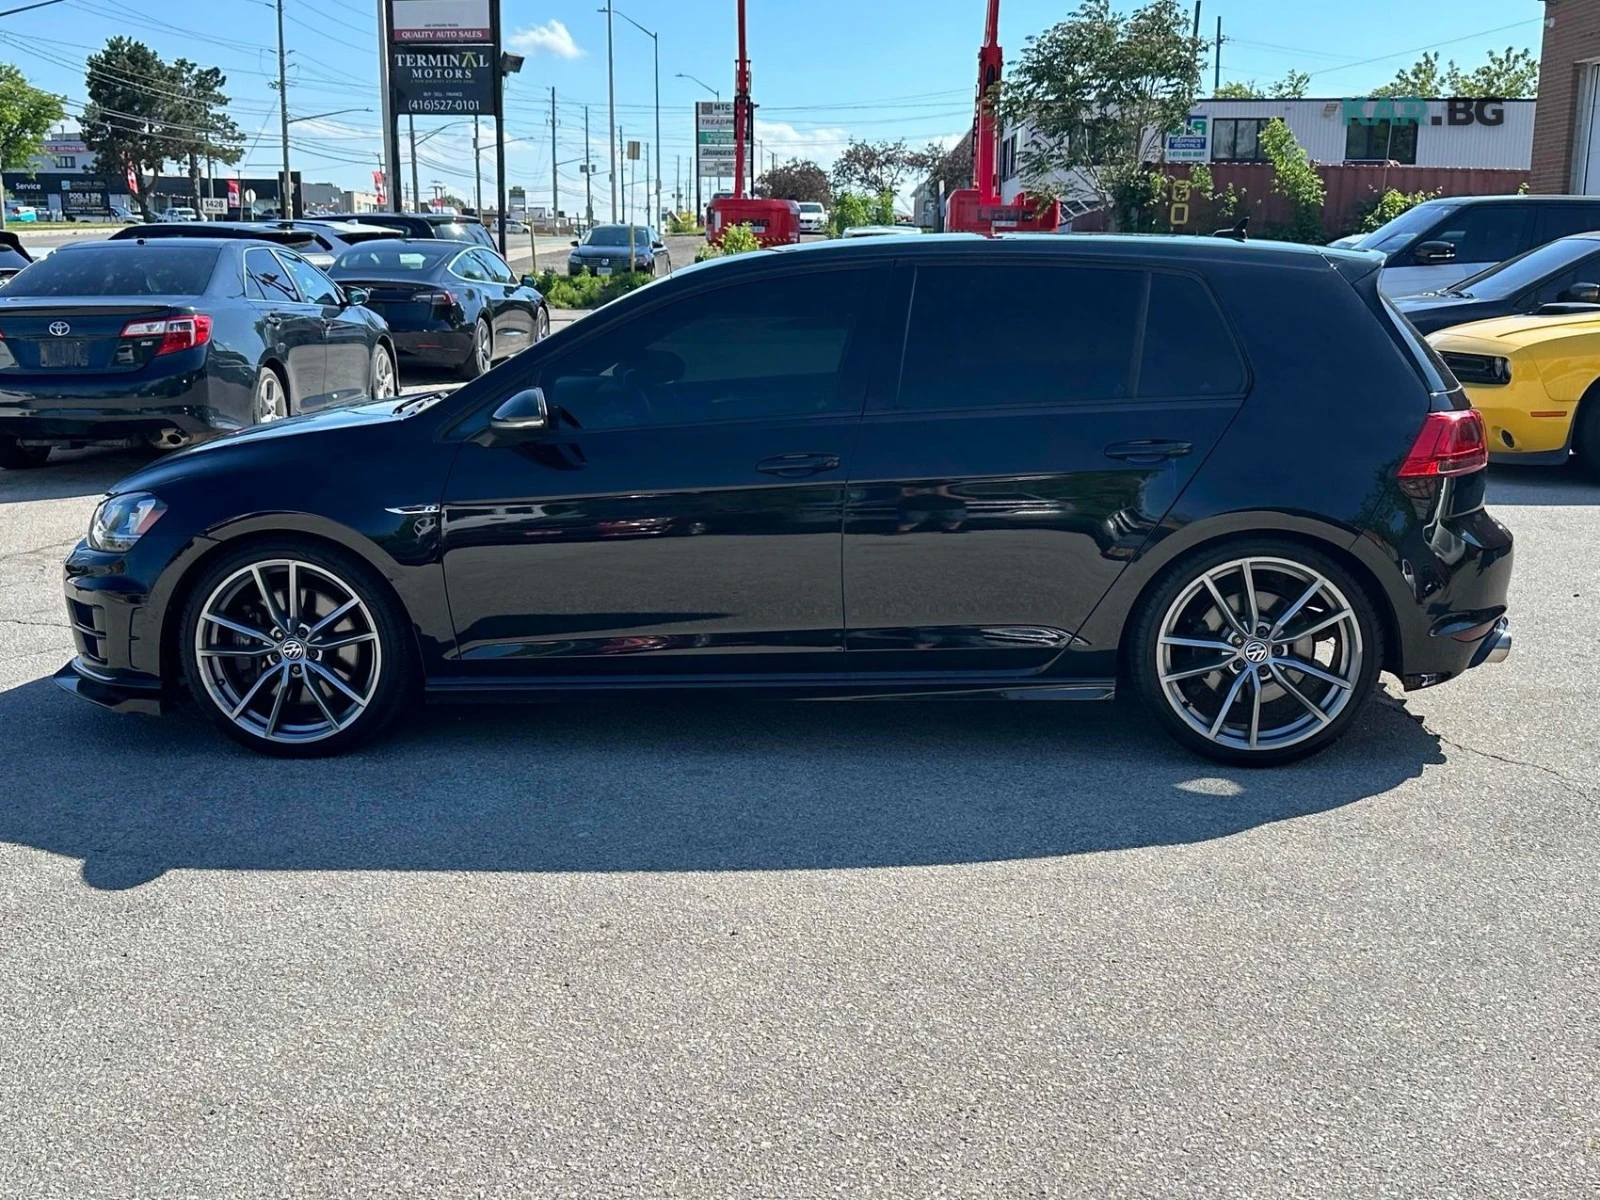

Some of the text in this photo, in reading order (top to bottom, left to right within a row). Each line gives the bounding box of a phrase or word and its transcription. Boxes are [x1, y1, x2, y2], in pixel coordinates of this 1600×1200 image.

[401, 31, 434, 39] QUALITY
[394, 51, 489, 68] TERMINAL
[412, 69, 472, 78] MOTORS
[408, 100, 480, 111] (416)527-0101
[15, 182, 41, 190] Service
[205, 200, 223, 208] 1428
